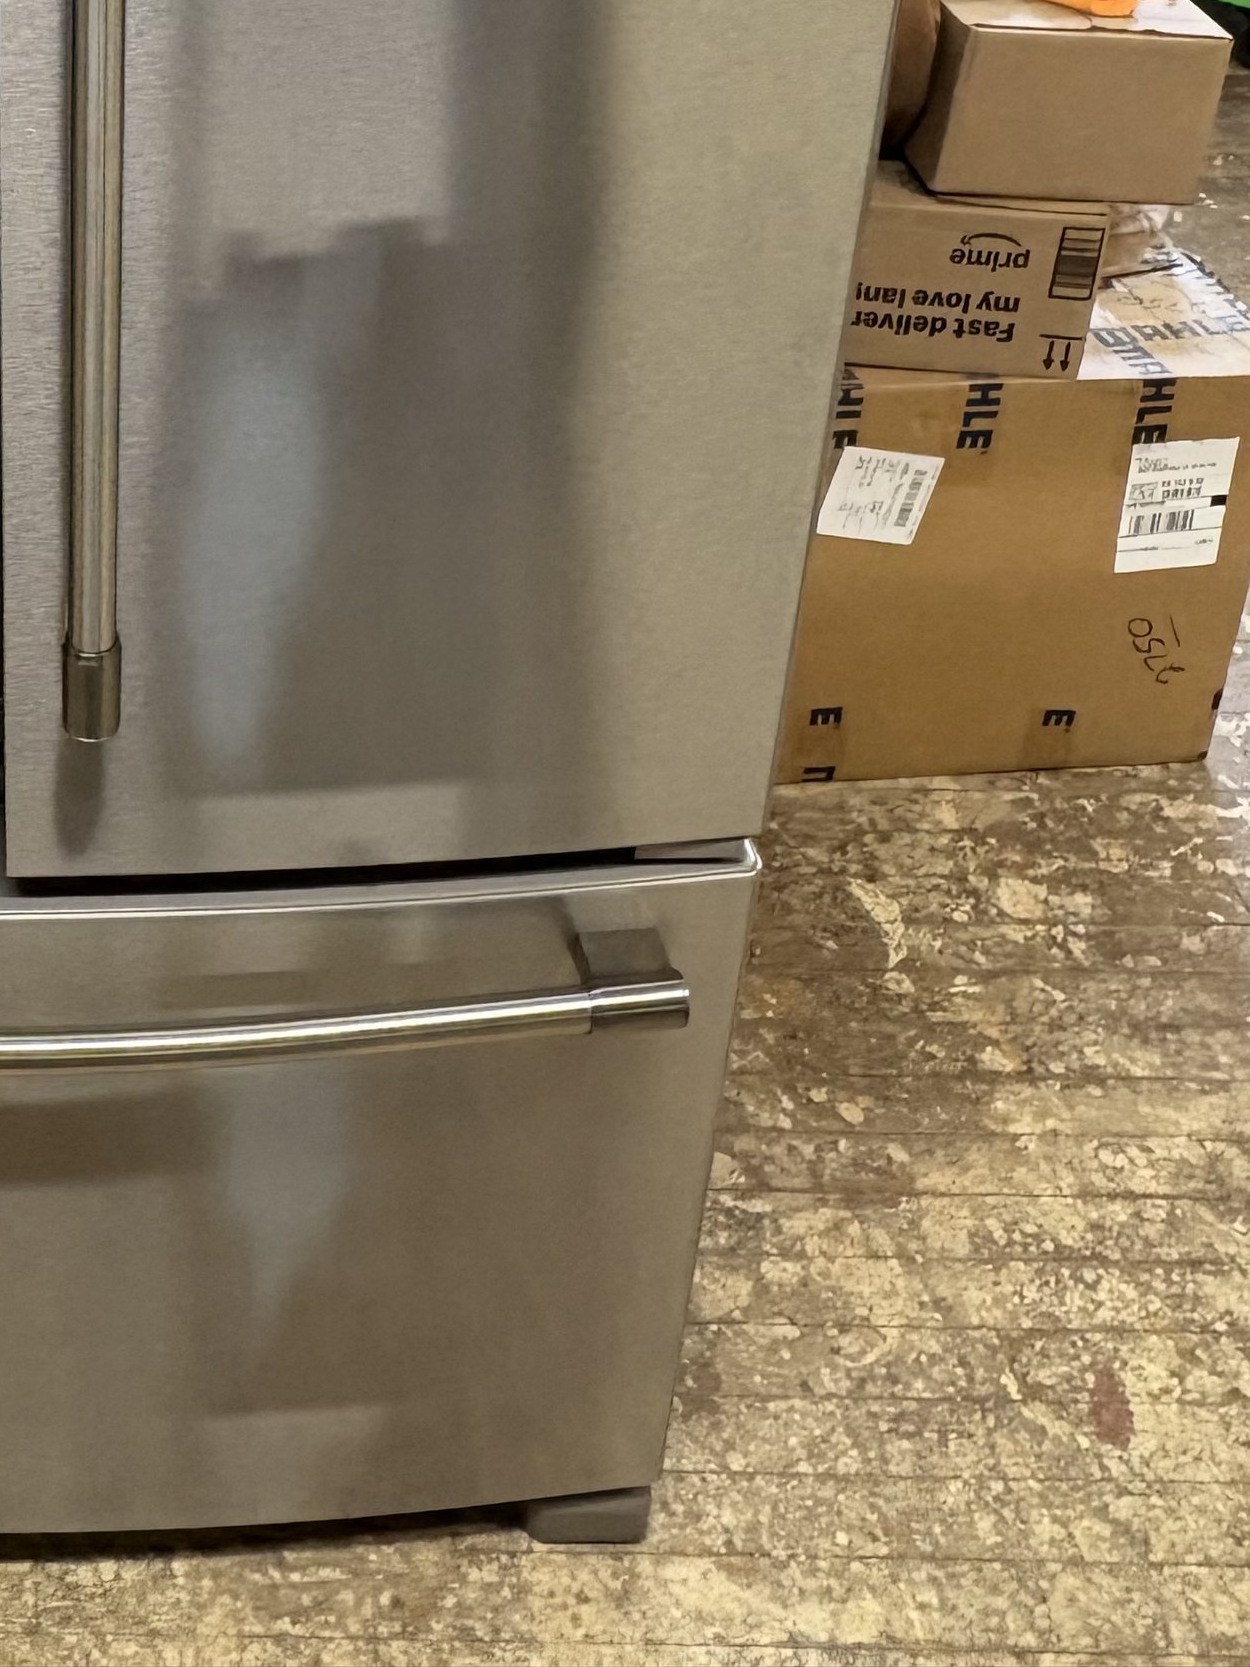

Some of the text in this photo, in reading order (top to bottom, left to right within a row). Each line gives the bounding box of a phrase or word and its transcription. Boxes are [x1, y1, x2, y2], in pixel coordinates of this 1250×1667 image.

[950, 248, 1031, 272] prime
[912, 289, 970, 313] love
[976, 290, 1020, 312] my
[953, 317, 1016, 342] Fast
